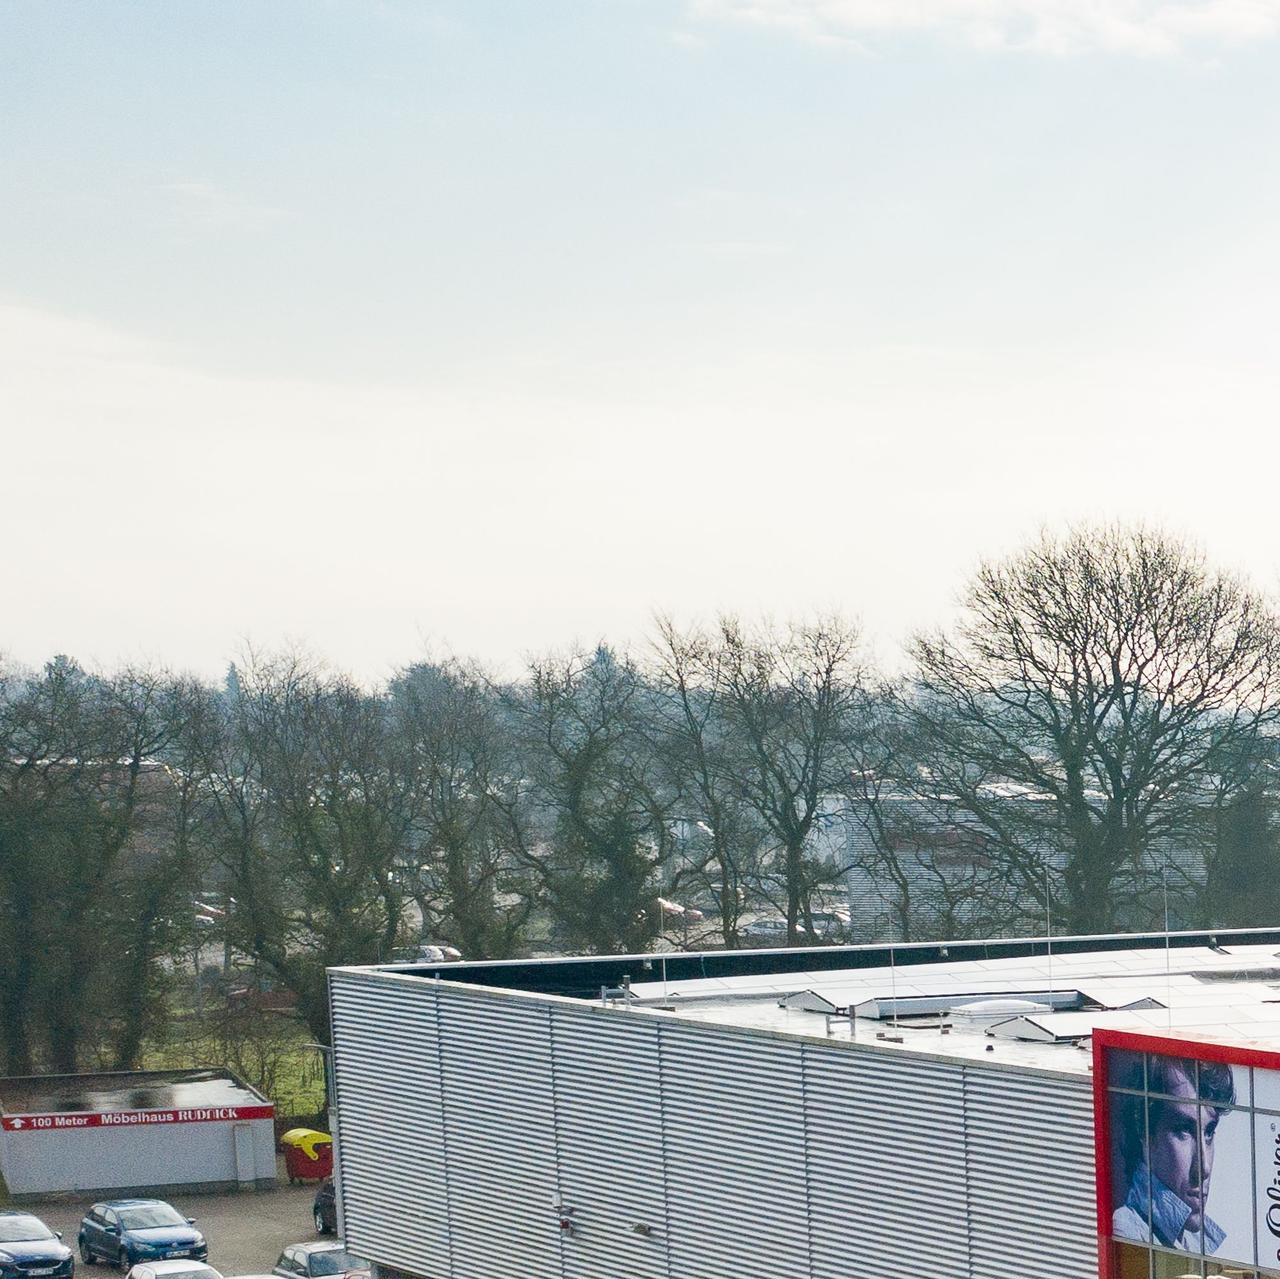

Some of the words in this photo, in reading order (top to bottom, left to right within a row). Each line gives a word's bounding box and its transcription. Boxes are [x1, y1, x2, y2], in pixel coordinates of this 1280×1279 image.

[31, 1118, 51, 1127] 100
[54, 1116, 89, 1127] Meter
[101, 1112, 174, 1124] Möbelhaus
